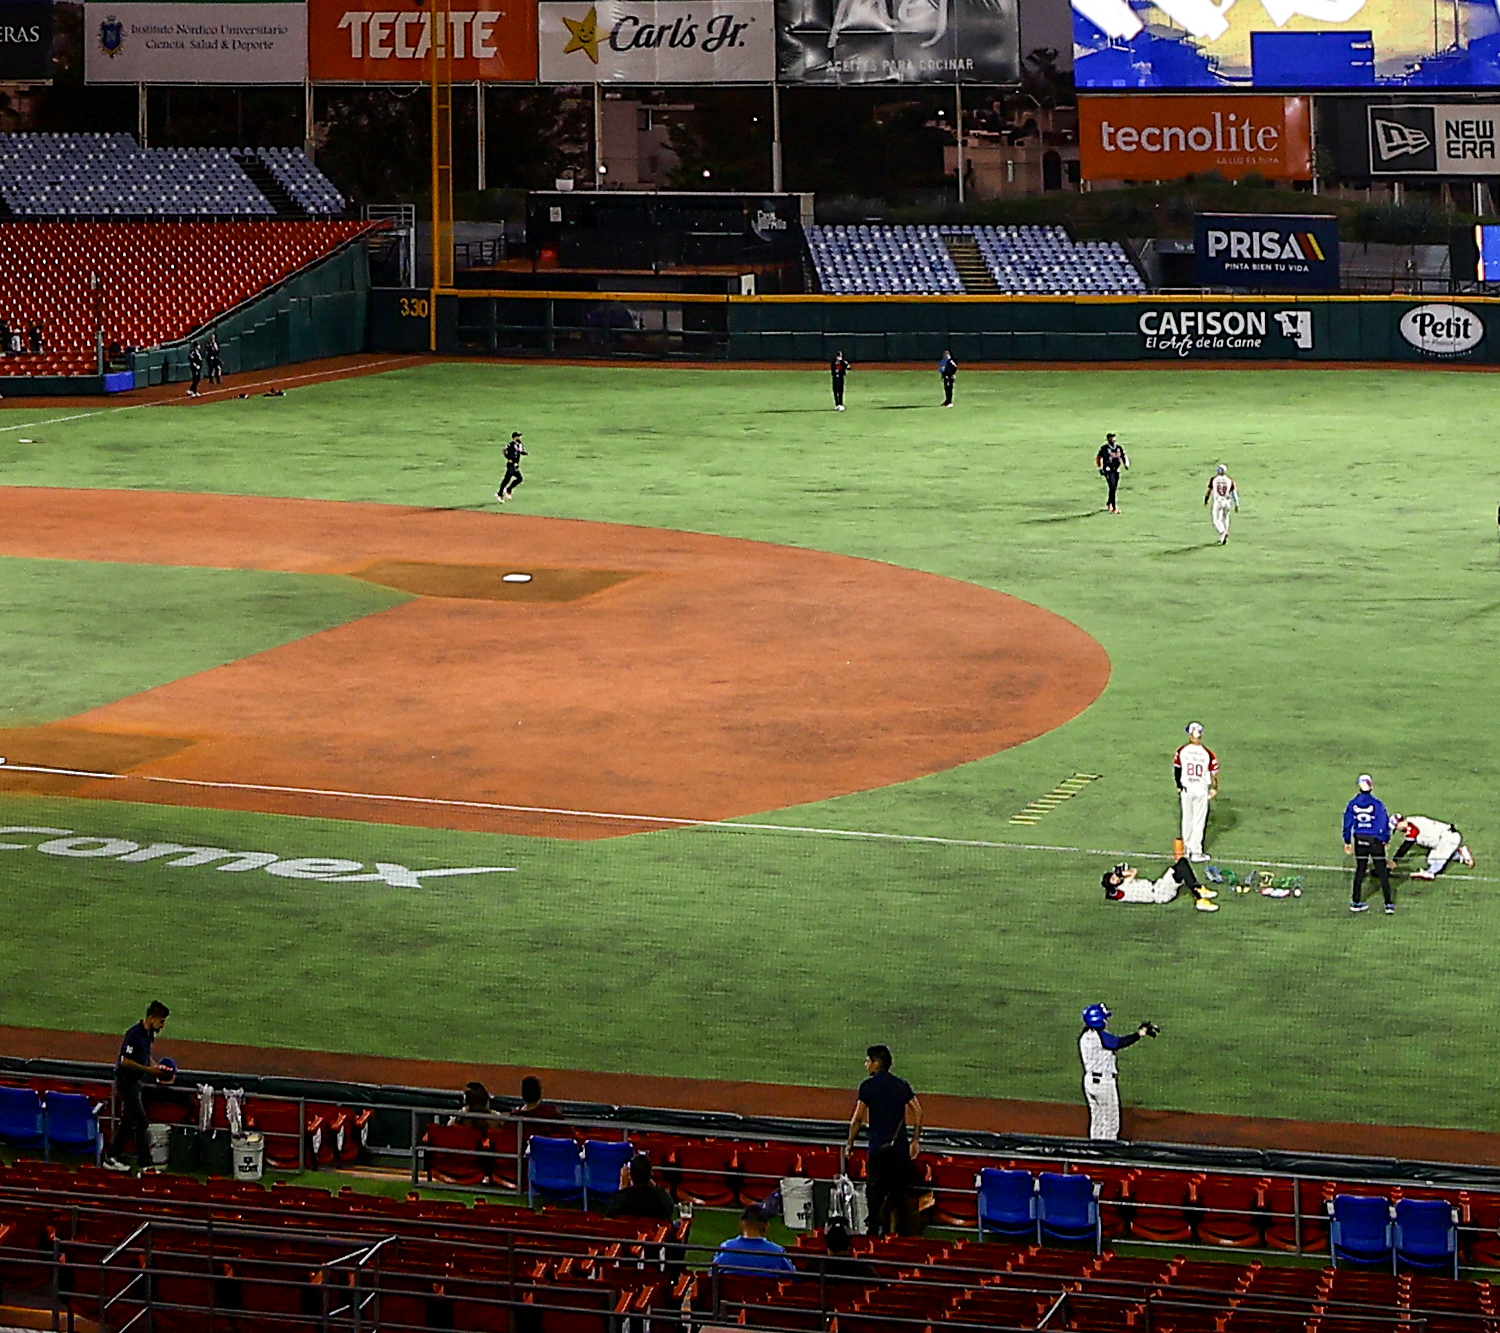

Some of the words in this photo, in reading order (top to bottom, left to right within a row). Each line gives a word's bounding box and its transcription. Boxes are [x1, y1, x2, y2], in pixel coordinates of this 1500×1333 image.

[131, 24, 174, 35] Instituto
[220, 24, 288, 35] Universitario
[337, 11, 502, 59] TECATE
[609, 14, 699, 52] Carl's
[701, 14, 746, 53] Jr.
[190, 39, 219, 50] Salud
[221, 40, 230, 50] &
[232, 40, 274, 53] Deporte
[882, 59, 914, 73] PARA
[919, 58, 975, 72] COCINAR
[1101, 111, 1280, 152] tecnolite
[1445, 120, 1495, 139] NEW
[1446, 140, 1495, 159] ERA
[1208, 230, 1308, 260] PRISA
[1224, 262, 1250, 271] PINTA
[1252, 262, 1272, 271] BIEN
[1275, 263, 1286, 272] TU
[1288, 263, 1310, 273] VIDA
[400, 298, 428, 318] 330
[1139, 311, 1267, 336] CAFISON
[1411, 313, 1473, 339] Petit
[1146, 337, 1157, 349] El
[1159, 334, 1193, 357] Arte
[1196, 336, 1212, 349] de
[1213, 336, 1225, 349] la
[1226, 336, 1262, 349] Carne
[1187, 763, 1204, 778] 80
